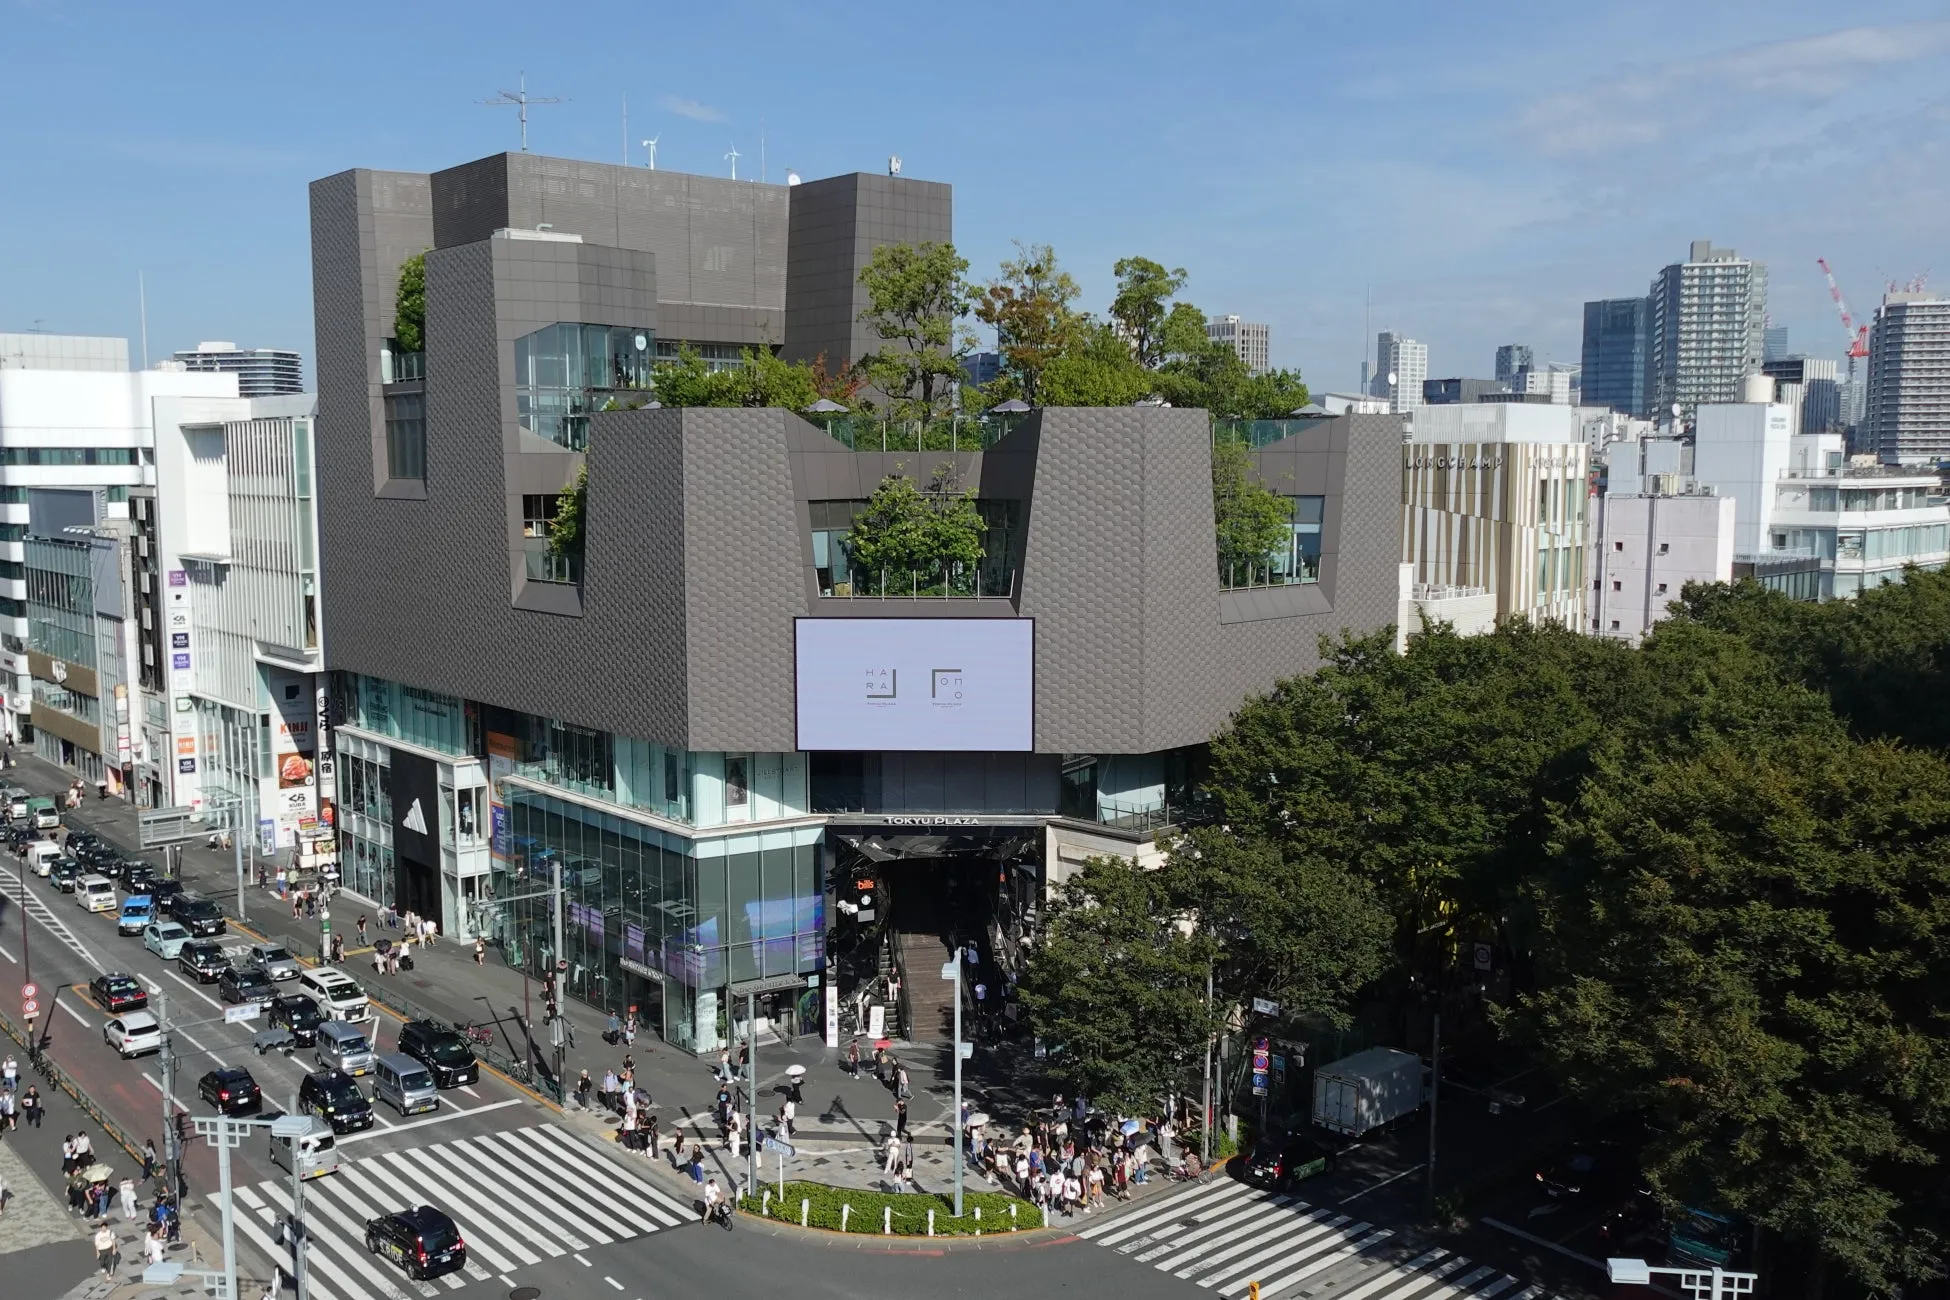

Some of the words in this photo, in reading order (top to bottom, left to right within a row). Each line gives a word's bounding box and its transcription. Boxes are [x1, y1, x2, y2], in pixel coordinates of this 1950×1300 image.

[1405, 456, 1503, 470] LONGCHAMP
[1528, 456, 1580, 469] LONGCHAMP
[320, 750, 332, 773] 原宿
[288, 793, 306, 802] くら
[885, 816, 930, 824] TOKYU
[934, 816, 980, 825] PLAZA
[857, 879, 874, 890] bills
